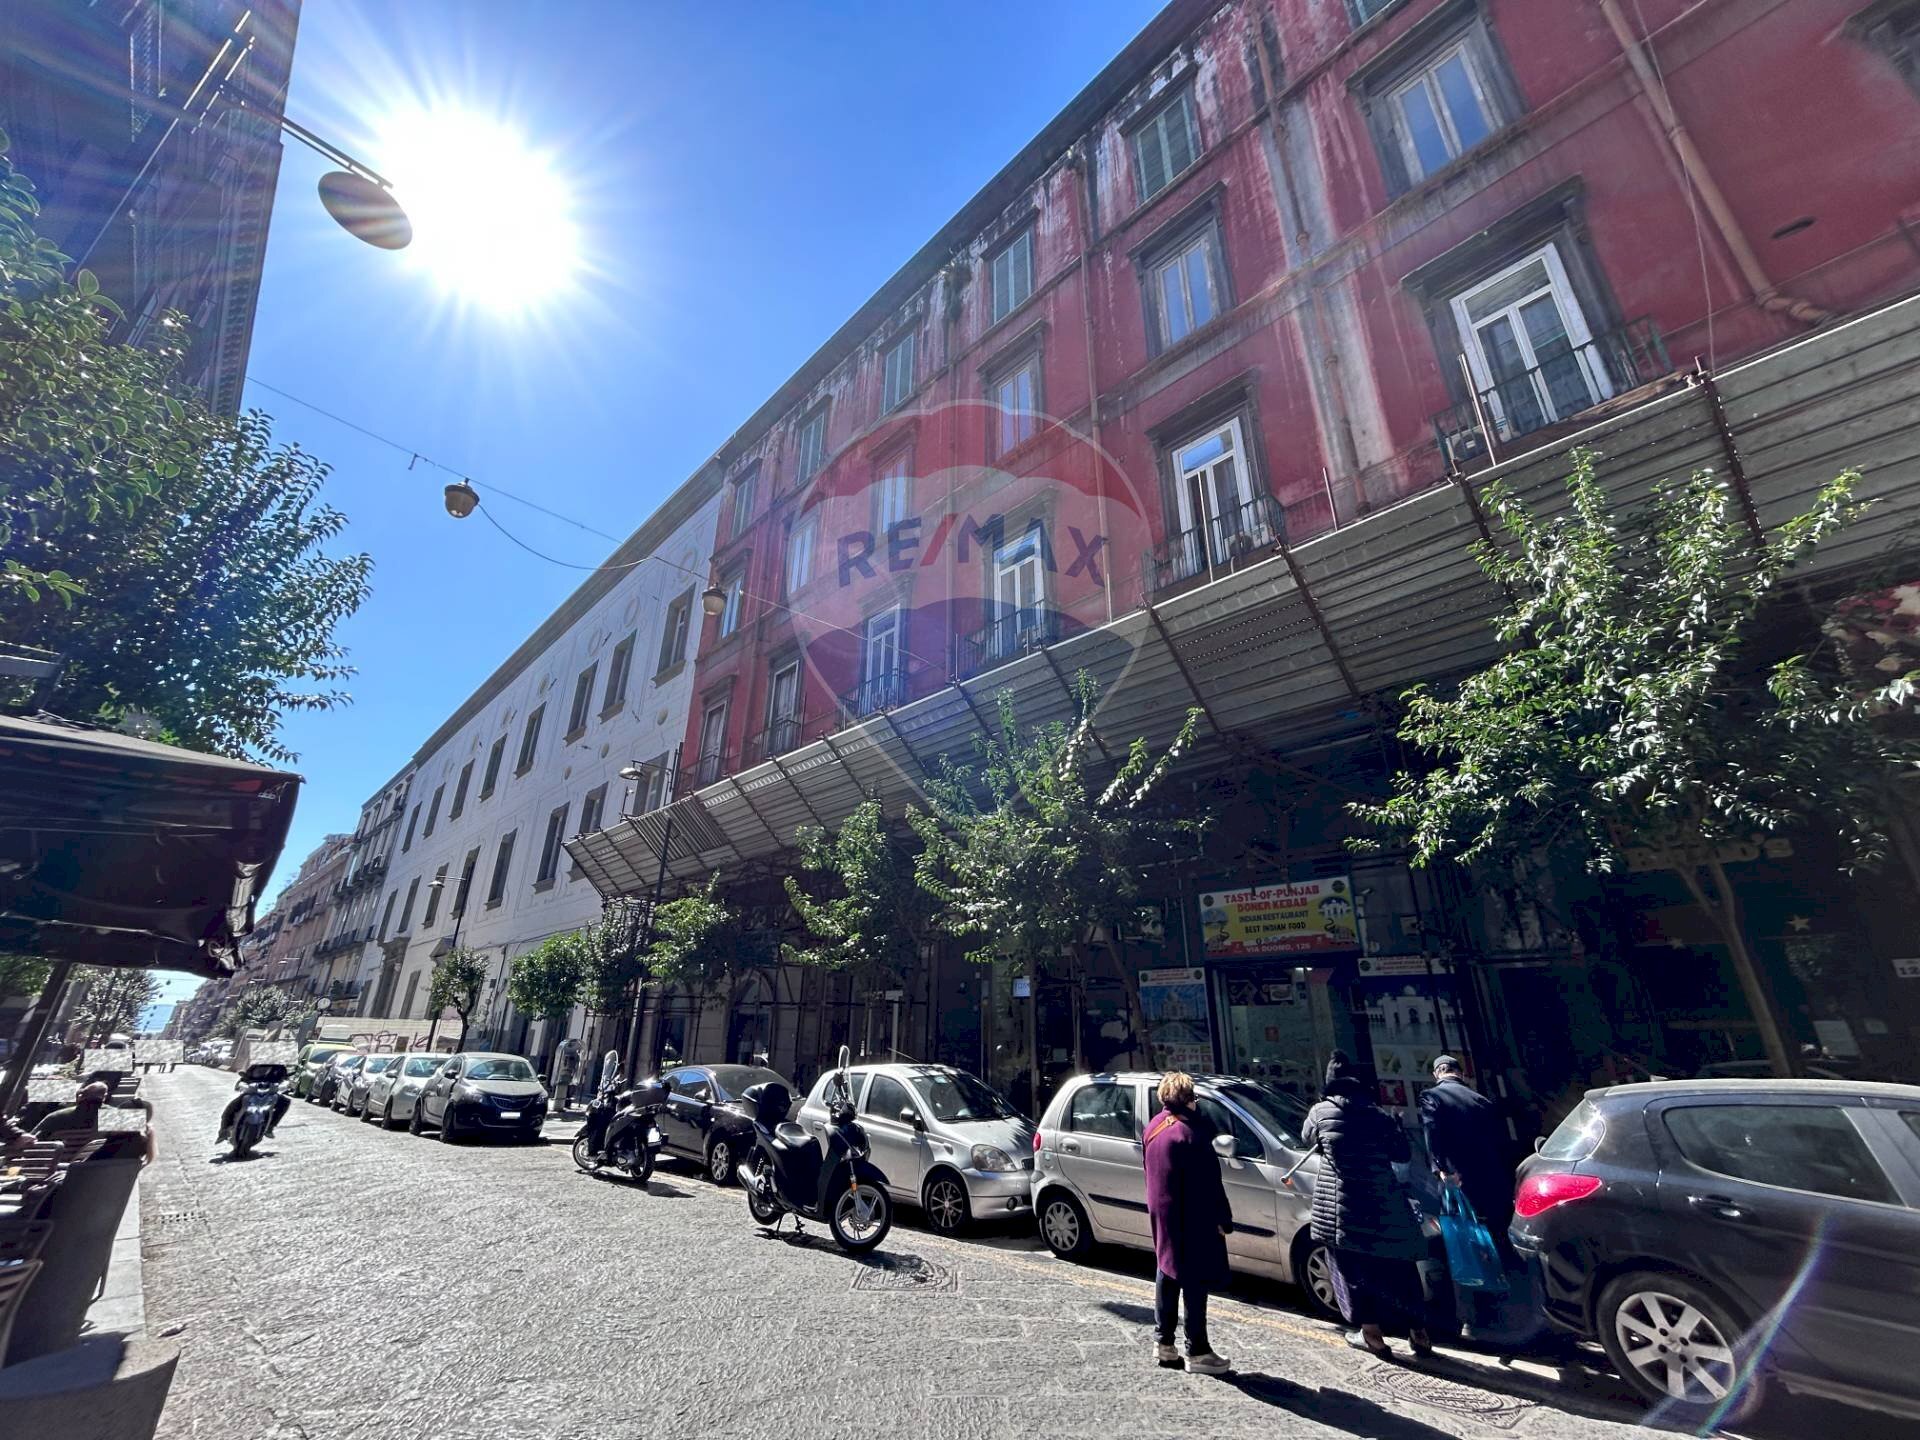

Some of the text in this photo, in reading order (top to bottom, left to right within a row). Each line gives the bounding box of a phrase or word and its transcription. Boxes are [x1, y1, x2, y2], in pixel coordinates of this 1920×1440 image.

[1272, 897, 1307, 909] KEBAB
[1263, 911, 1308, 921] RESTAURANT
[1245, 921, 1306, 934] BEST INDIAN FOOD
[1246, 945, 1260, 953] VIA
